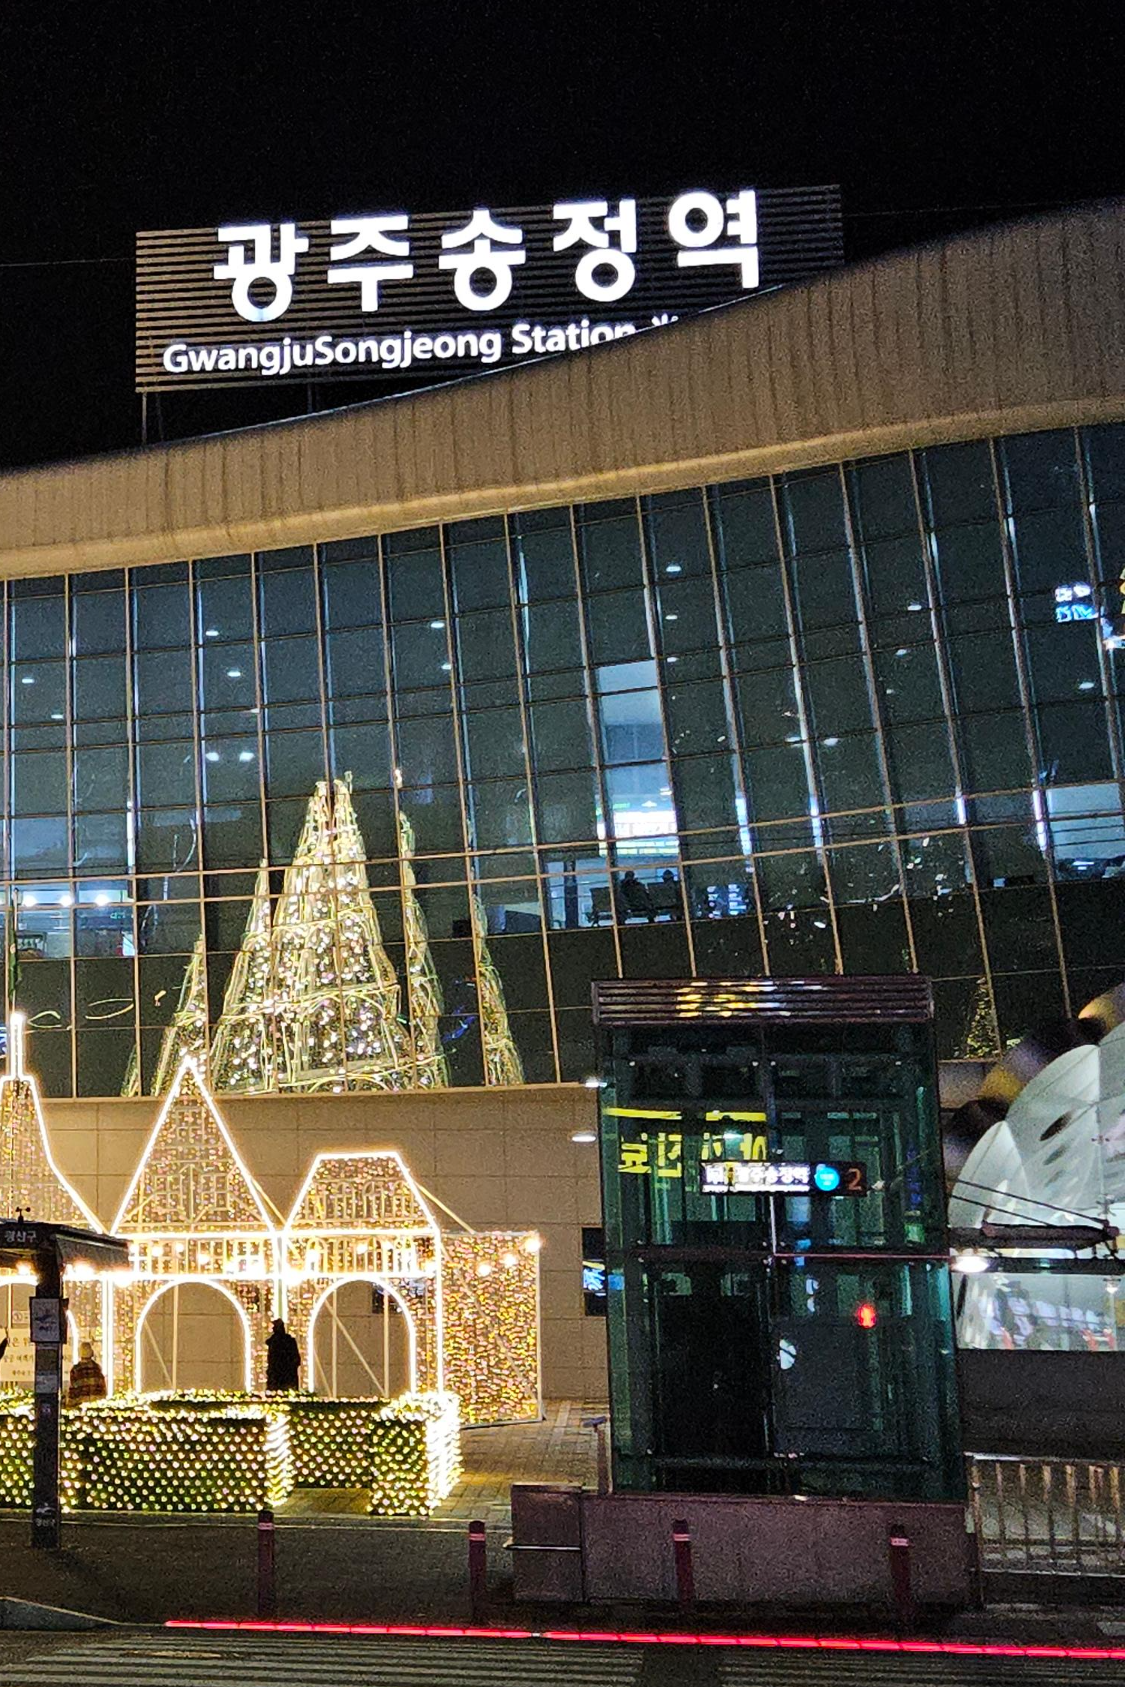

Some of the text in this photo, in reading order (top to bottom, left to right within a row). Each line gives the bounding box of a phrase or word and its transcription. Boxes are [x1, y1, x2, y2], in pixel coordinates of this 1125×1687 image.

[214, 189, 759, 322] 광주송정역
[163, 331, 501, 375] GwangjuSongjeong
[847, 1168, 862, 1191] 2
[4, 1230, 37, 1243] 광산구
